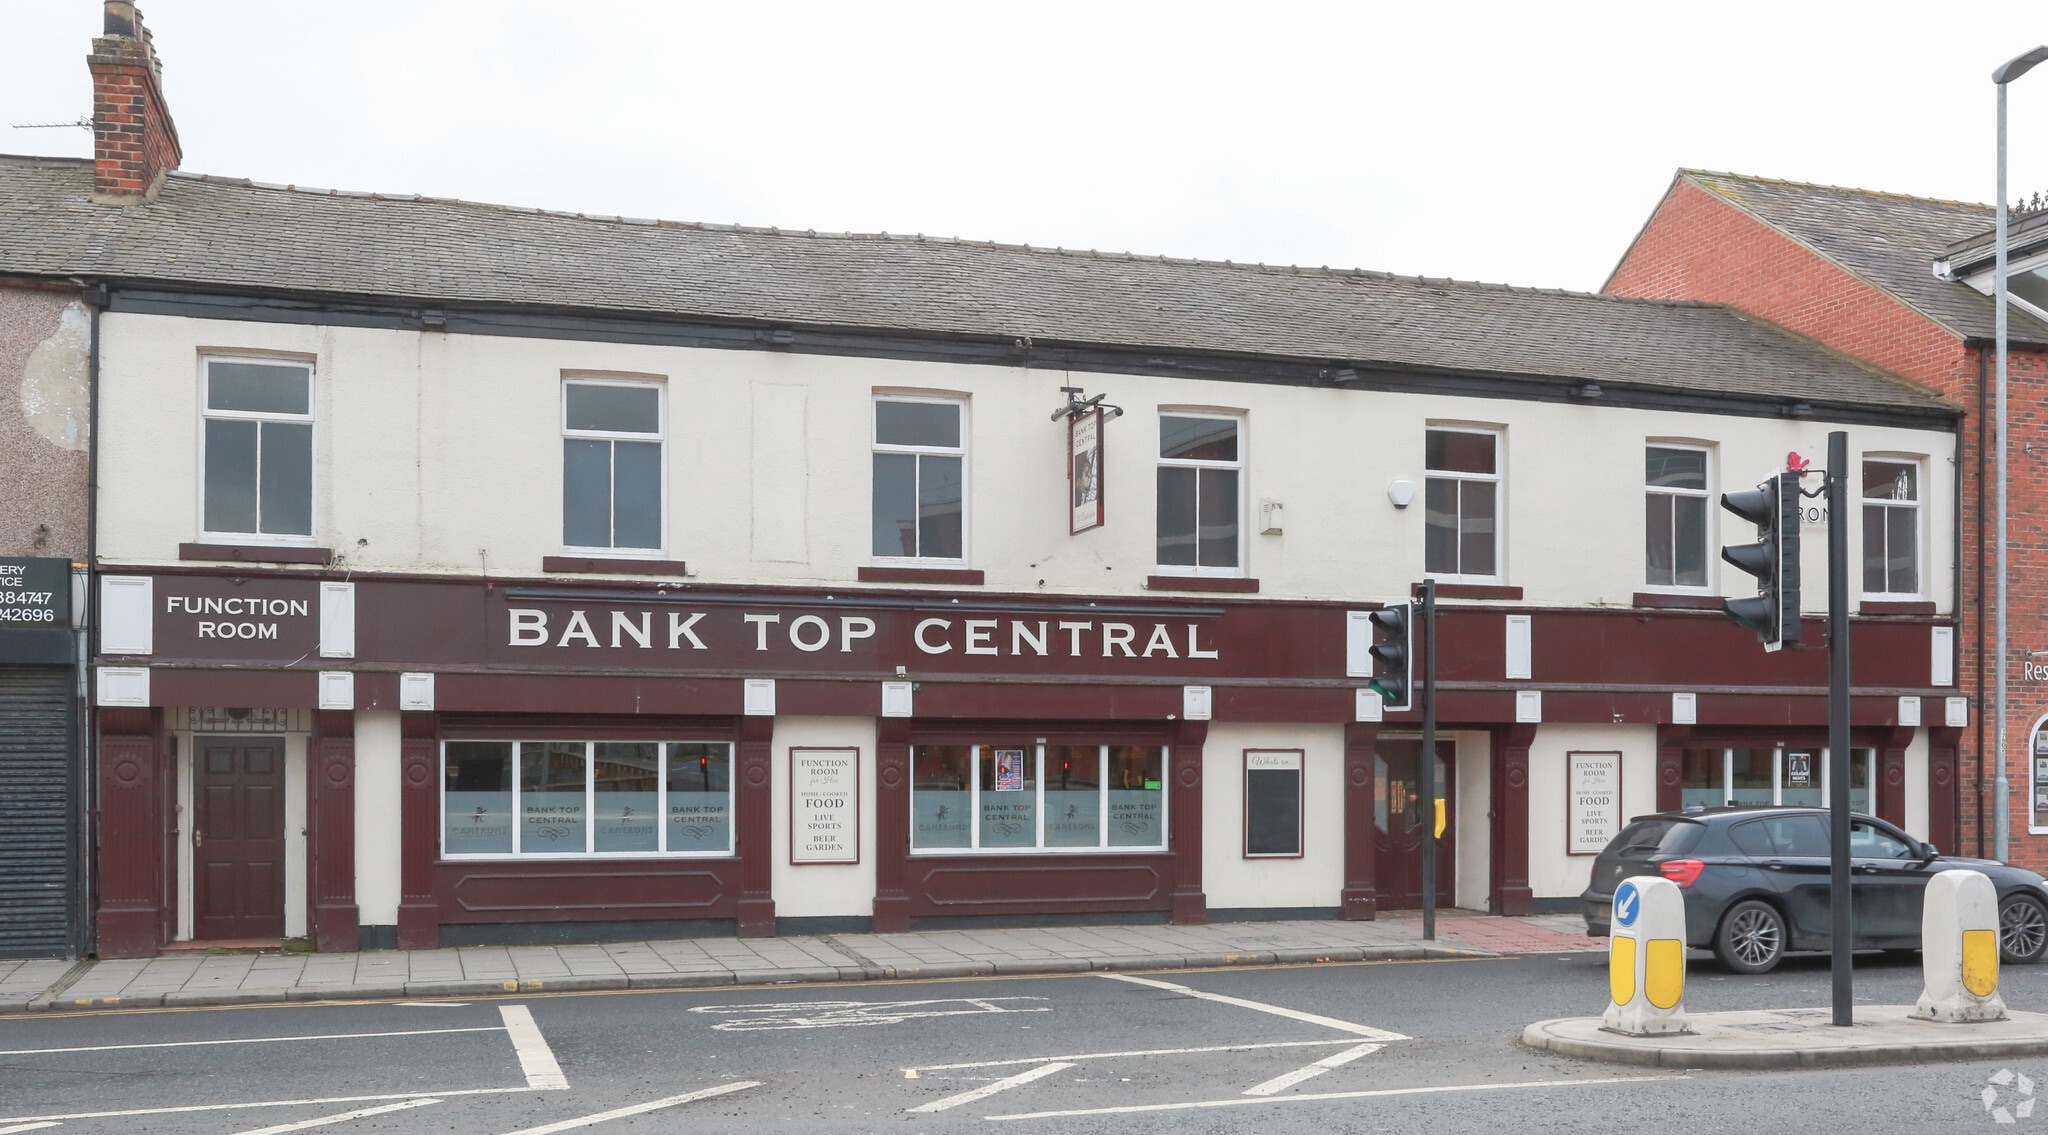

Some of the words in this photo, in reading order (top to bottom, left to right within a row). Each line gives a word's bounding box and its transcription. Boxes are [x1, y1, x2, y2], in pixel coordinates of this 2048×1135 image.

[167, 596, 308, 616] FUNCTION
[198, 621, 278, 639] ROOM
[508, 608, 708, 650] BANK
[744, 613, 877, 652] TOP
[914, 617, 1219, 660] CENTRAL
[810, 768, 839, 776] ROOM
[805, 798, 844, 809] FOOD
[1579, 796, 1610, 806] FOOD
[527, 806, 555, 814] BANK
[559, 806, 580, 814] TOP
[983, 804, 1009, 812] BANK
[1111, 803, 1136, 811] BANK
[1139, 803, 1157, 811] TOP
[528, 816, 578, 824] CENTRAL
[807, 822, 842, 830] SPORTS
[1579, 836, 1609, 844] GARDEN
